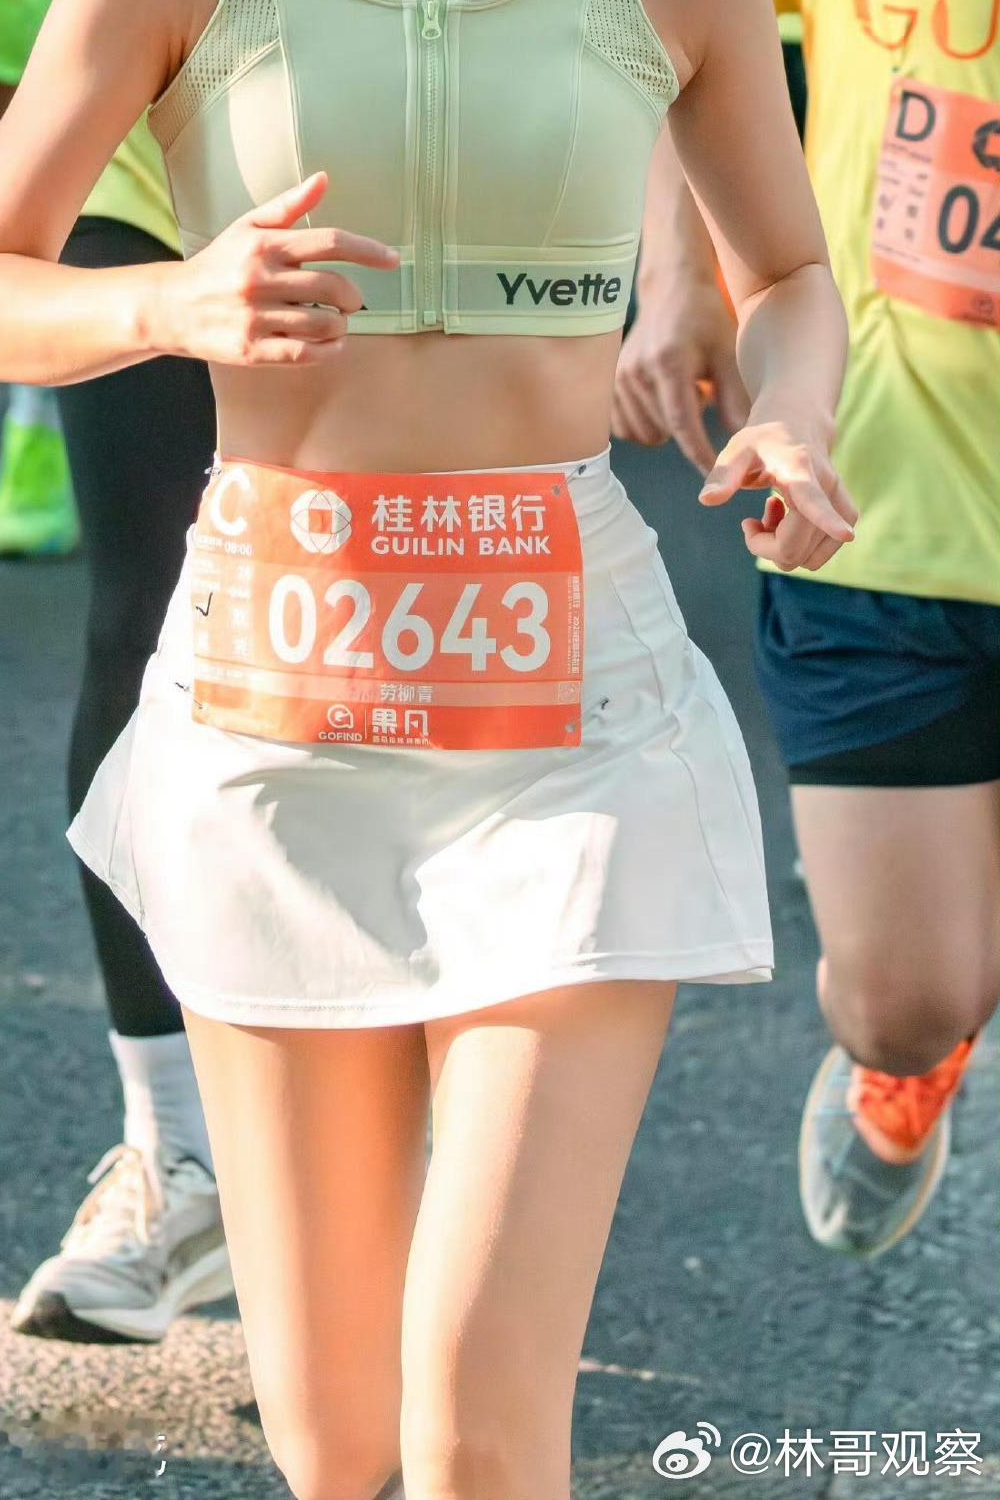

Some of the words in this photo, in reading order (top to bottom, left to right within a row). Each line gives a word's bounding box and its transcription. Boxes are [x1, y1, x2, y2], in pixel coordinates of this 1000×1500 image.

[895, 89, 936, 143] D
[496, 272, 622, 307] Yvette
[210, 467, 252, 537] C
[371, 493, 547, 534] 桂林银行
[370, 536, 466, 557] GUILIN
[478, 535, 552, 557] BANK
[268, 573, 552, 673] 02643
[317, 730, 363, 743] GOFIND
